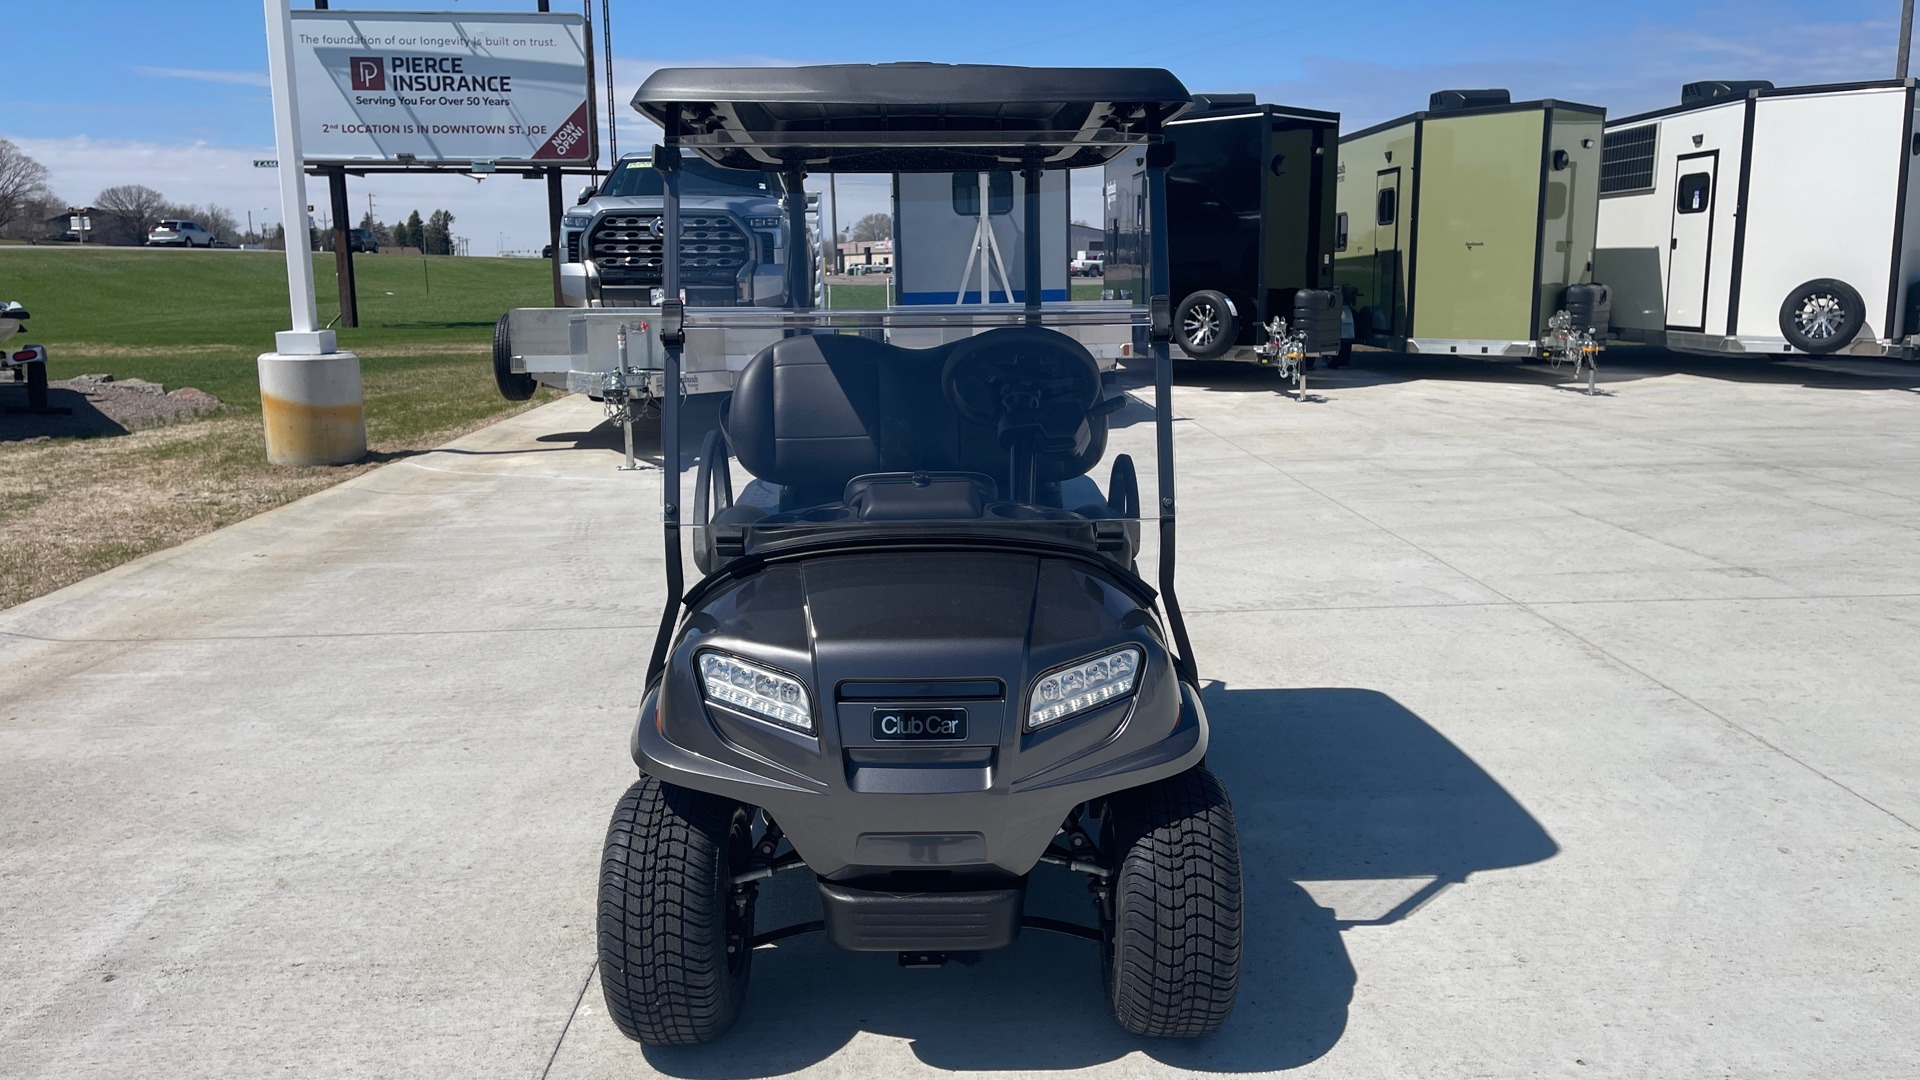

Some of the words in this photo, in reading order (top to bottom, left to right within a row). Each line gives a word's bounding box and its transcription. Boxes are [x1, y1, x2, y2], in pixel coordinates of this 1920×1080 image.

[299, 34, 319, 44] The
[322, 35, 381, 45] foundation
[385, 35, 396, 45] of
[398, 38, 417, 46] our
[420, 36, 470, 48] longevity
[485, 37, 510, 47] built
[512, 38, 526, 47] on
[530, 37, 557, 47] trust.
[391, 57, 464, 74] PIERCE
[393, 75, 512, 92] INSURANCE
[355, 96, 396, 107] Serving
[398, 96, 418, 106] You
[420, 97, 437, 106] For
[438, 97, 464, 106] Over
[466, 97, 481, 106] 50
[482, 97, 510, 106] Years
[341, 125, 400, 134] LOCATION
[403, 125, 414, 134] IS
[417, 125, 429, 134] IN
[432, 125, 505, 134] DOWNTOWN
[508, 125, 526, 135] ST.
[527, 125, 547, 136] JOE
[551, 121, 577, 147] NOW
[556, 126, 585, 155] OPEN!
[880, 715, 924, 735] Club
[925, 715, 959, 735] Car
